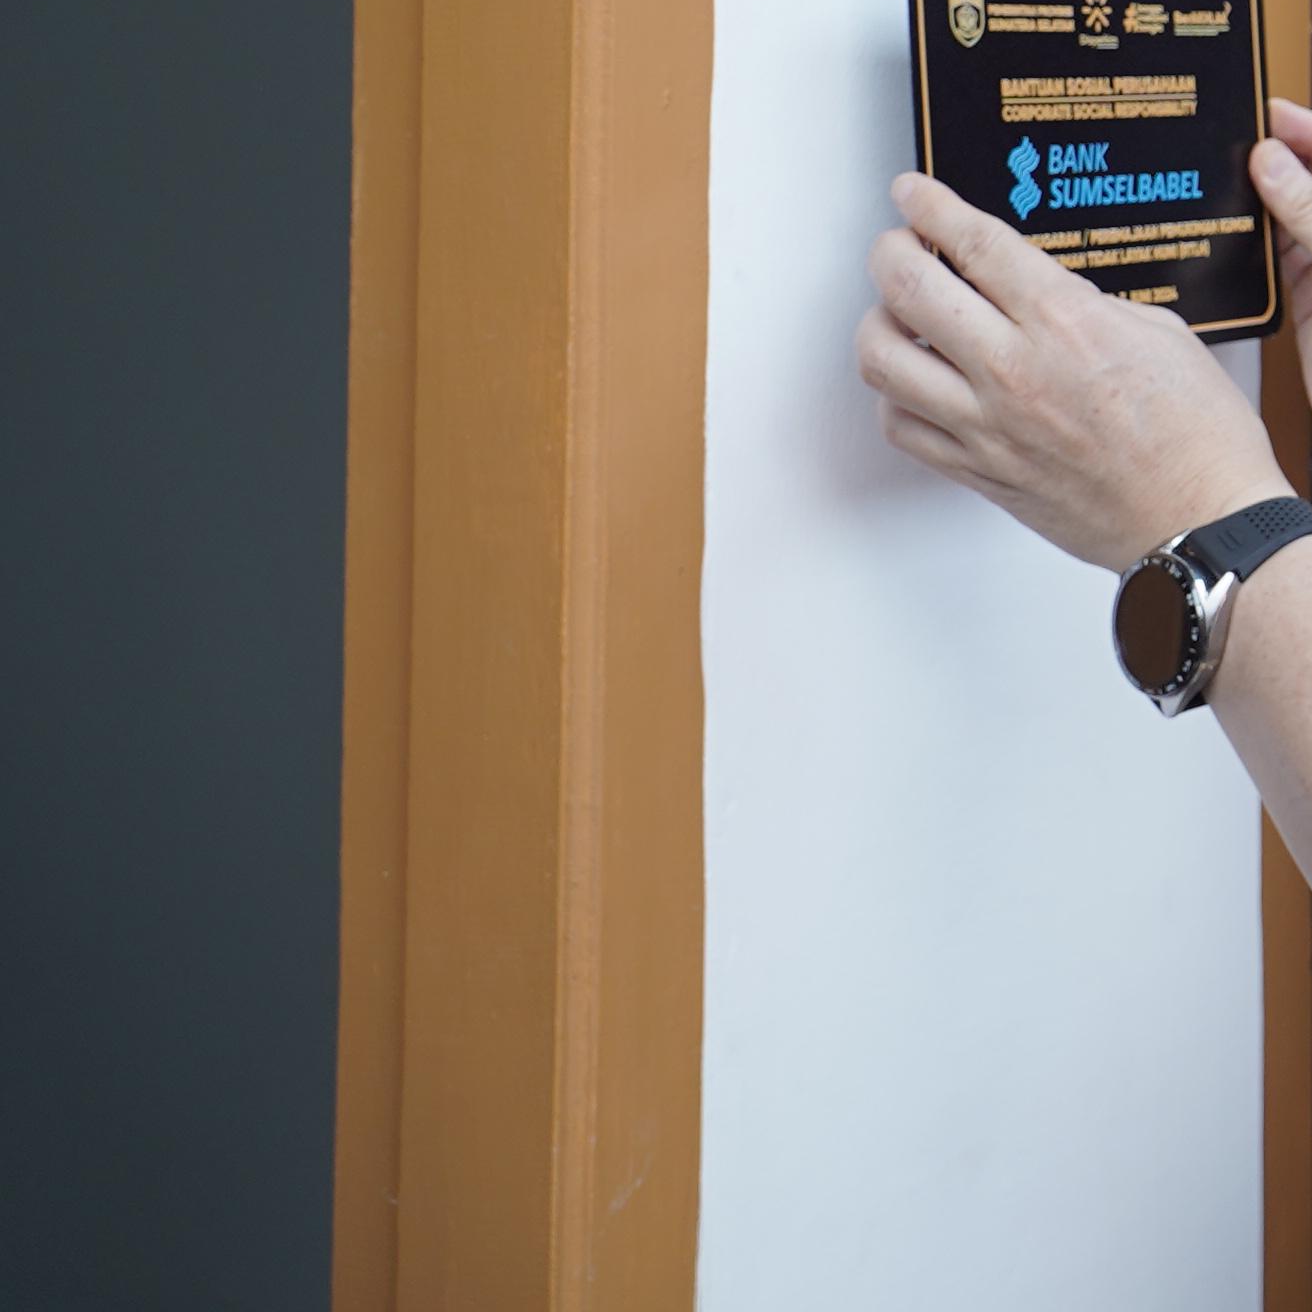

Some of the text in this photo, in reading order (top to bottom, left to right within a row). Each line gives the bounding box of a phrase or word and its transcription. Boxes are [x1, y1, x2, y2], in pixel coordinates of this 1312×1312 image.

[1000, 74, 1197, 97] BANTUAN SOSIAL PERUSAHAAN
[1002, 103, 1073, 122] CORPORATE
[1073, 102, 1114, 120] SOCIAL
[1048, 142, 1110, 175] BANK
[1048, 170, 1204, 209] SUMSELBABEL
